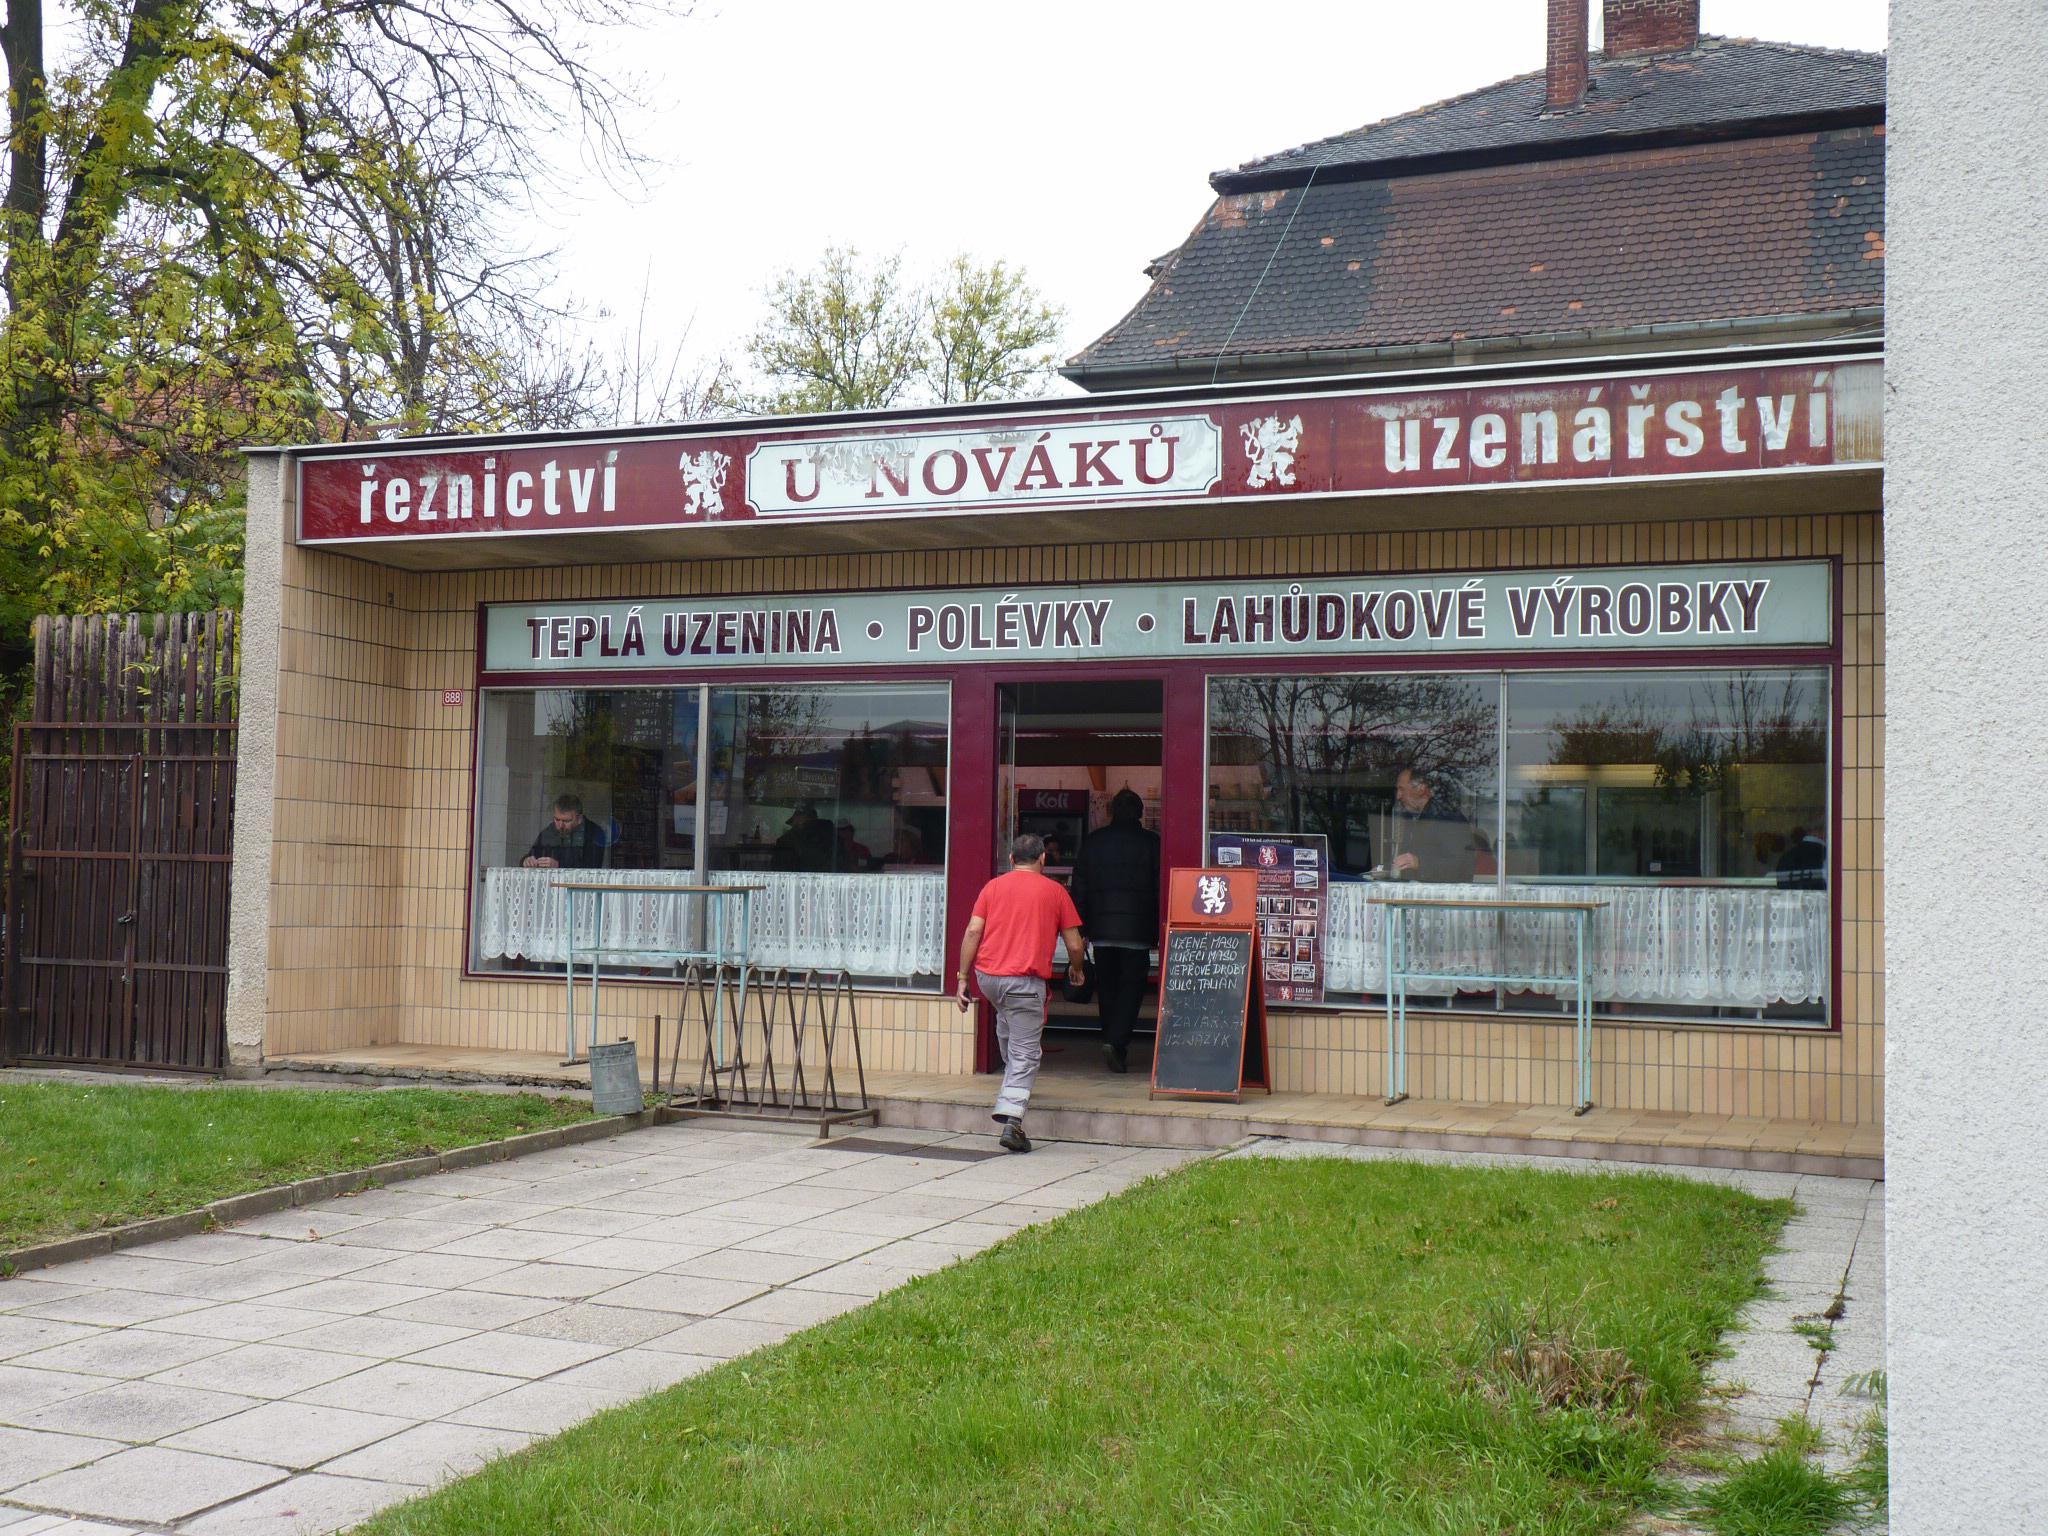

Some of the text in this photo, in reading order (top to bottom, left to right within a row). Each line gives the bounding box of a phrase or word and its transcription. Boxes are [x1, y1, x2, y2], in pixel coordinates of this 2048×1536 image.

[1384, 372, 1830, 474] uzenářství
[781, 423, 1180, 502] U NOVÁKŮ
[360, 450, 620, 525] řeznictví
[527, 576, 1770, 660] TEPLÁ UZENINA POLÉVKY LAHŮDKOVÉ VÝROBKY
[444, 691, 461, 704] 888
[1208, 950, 1238, 962] MASO
[1211, 936, 1240, 950] MASO
[1170, 960, 1247, 976] VEPŘOVÉ DROBY
